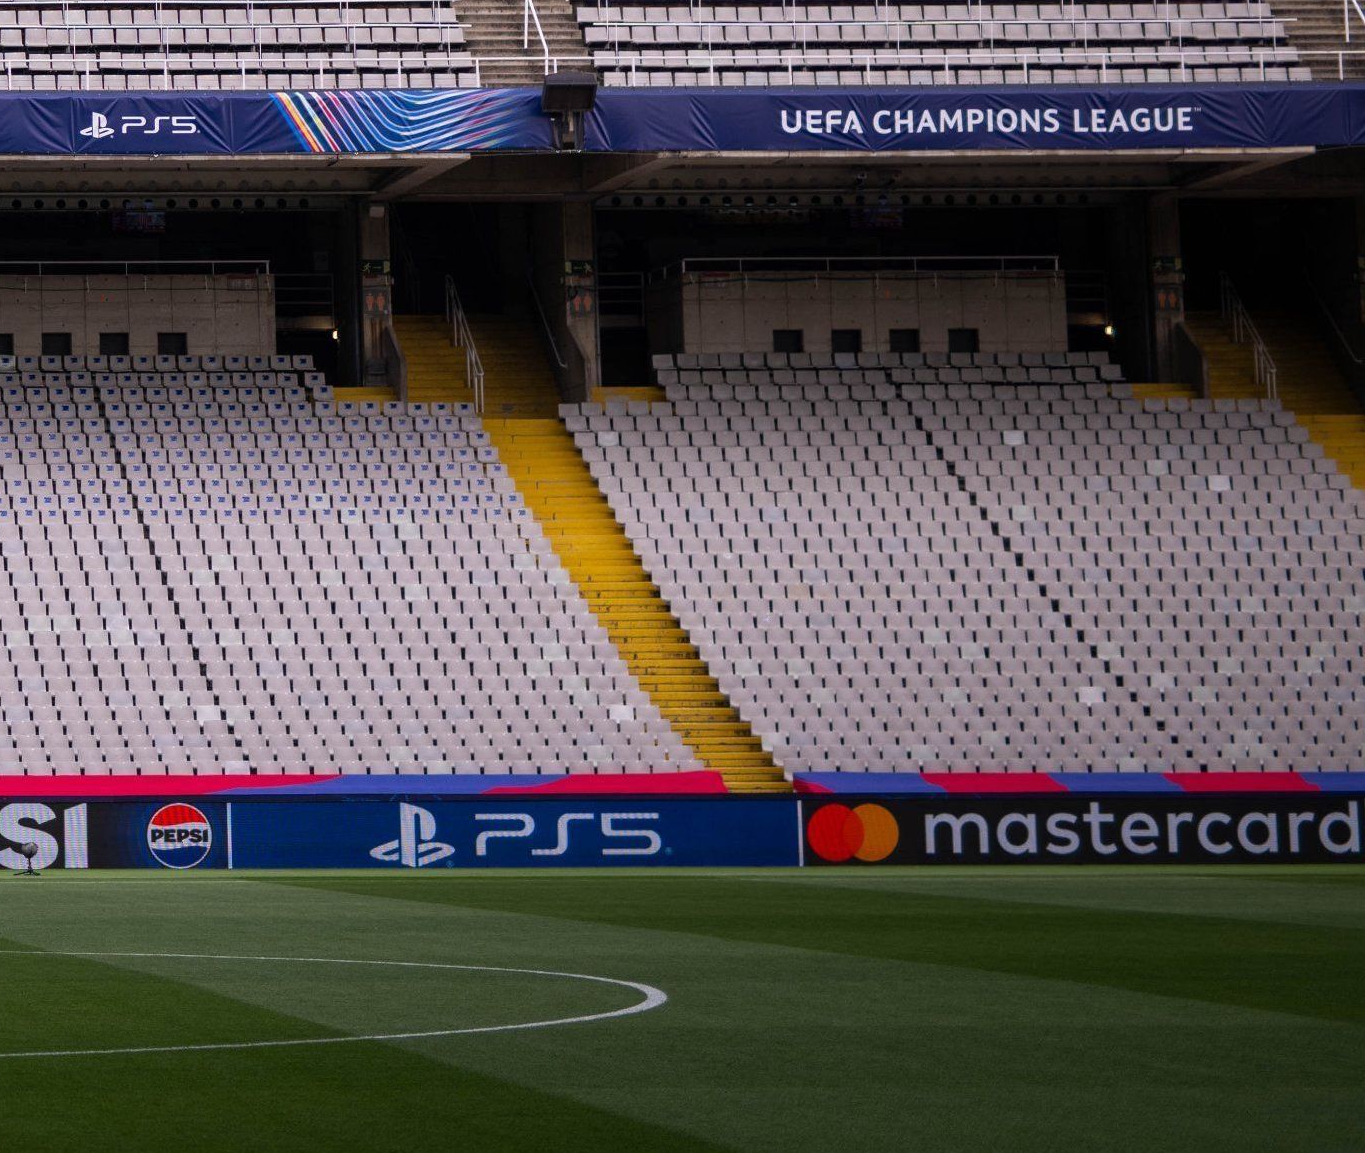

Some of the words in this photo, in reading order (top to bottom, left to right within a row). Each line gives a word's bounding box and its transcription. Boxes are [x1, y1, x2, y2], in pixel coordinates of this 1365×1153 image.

[121, 116, 197, 134] PS5
[780, 109, 864, 134] UEFA
[873, 108, 1060, 134] CHAMPIONS
[150, 827, 210, 844] PEPSI
[475, 812, 662, 856] PS5
[924, 800, 1360, 855] mastercard
